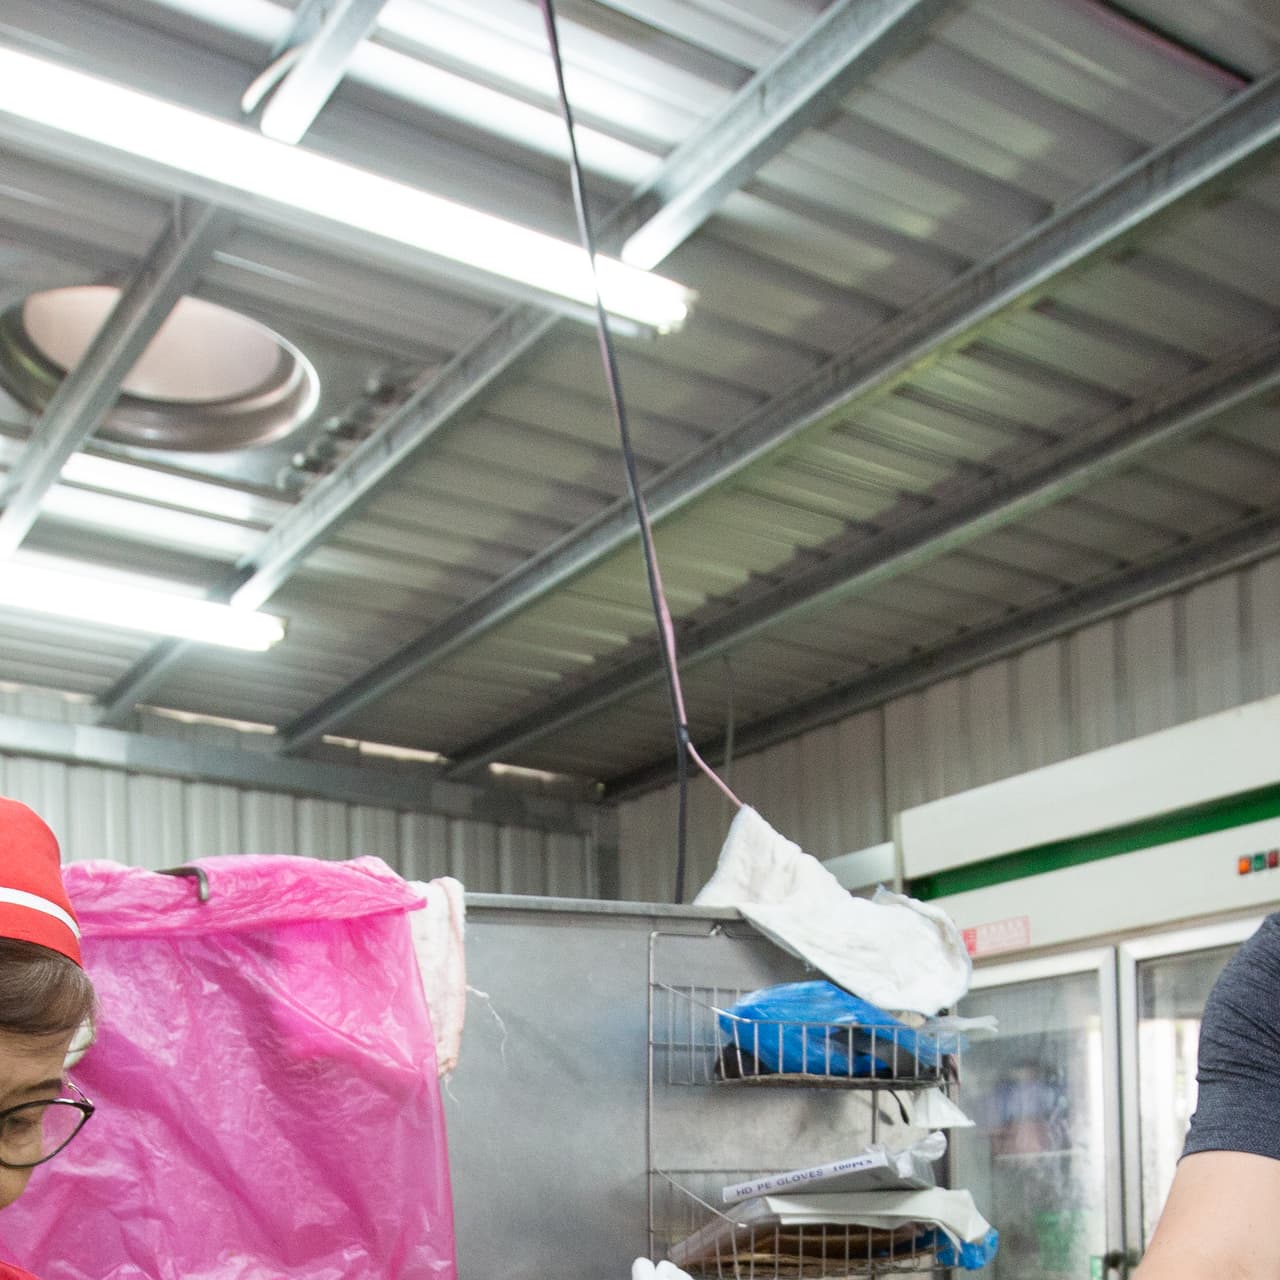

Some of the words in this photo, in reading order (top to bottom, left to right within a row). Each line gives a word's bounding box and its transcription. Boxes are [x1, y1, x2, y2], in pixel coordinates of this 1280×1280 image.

[736, 1186, 753, 1197] HD
[757, 1181, 772, 1192] PE
[776, 1168, 824, 1187] GLOVES
